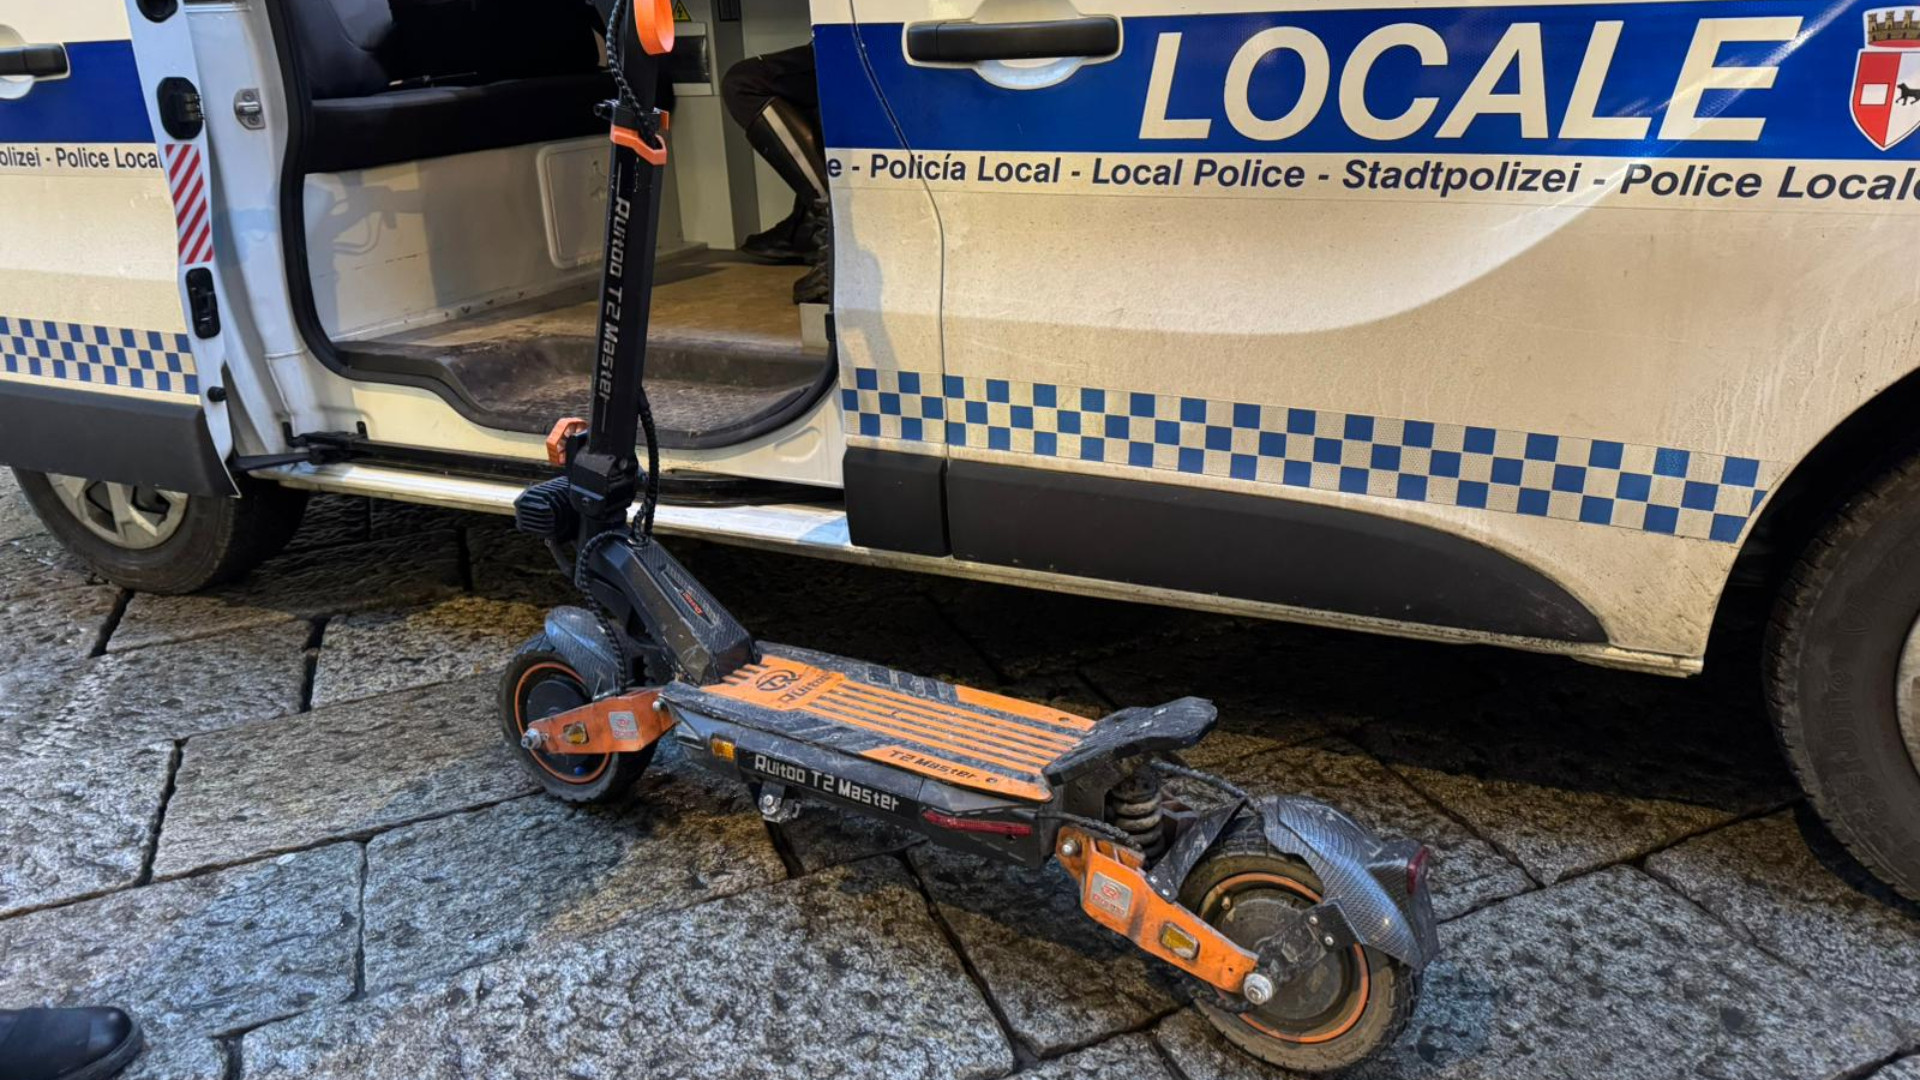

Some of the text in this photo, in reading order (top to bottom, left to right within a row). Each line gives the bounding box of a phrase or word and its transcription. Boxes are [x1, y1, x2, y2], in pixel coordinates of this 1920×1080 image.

[1139, 15, 1803, 141] LOCALE
[56, 147, 109, 168] Police
[870, 153, 966, 181] Policía
[977, 155, 1061, 183] Local
[1092, 157, 1184, 186] Local
[1193, 158, 1305, 187] Police
[1342, 159, 1582, 198] Stadtpolizei
[1619, 163, 1763, 198] Police
[1776, 166, 1920, 200] Local
[599, 196, 630, 401] Ruitoo T2 Master
[754, 753, 900, 812] Ruitoo T2 Master
[889, 749, 977, 779] T2 Master
